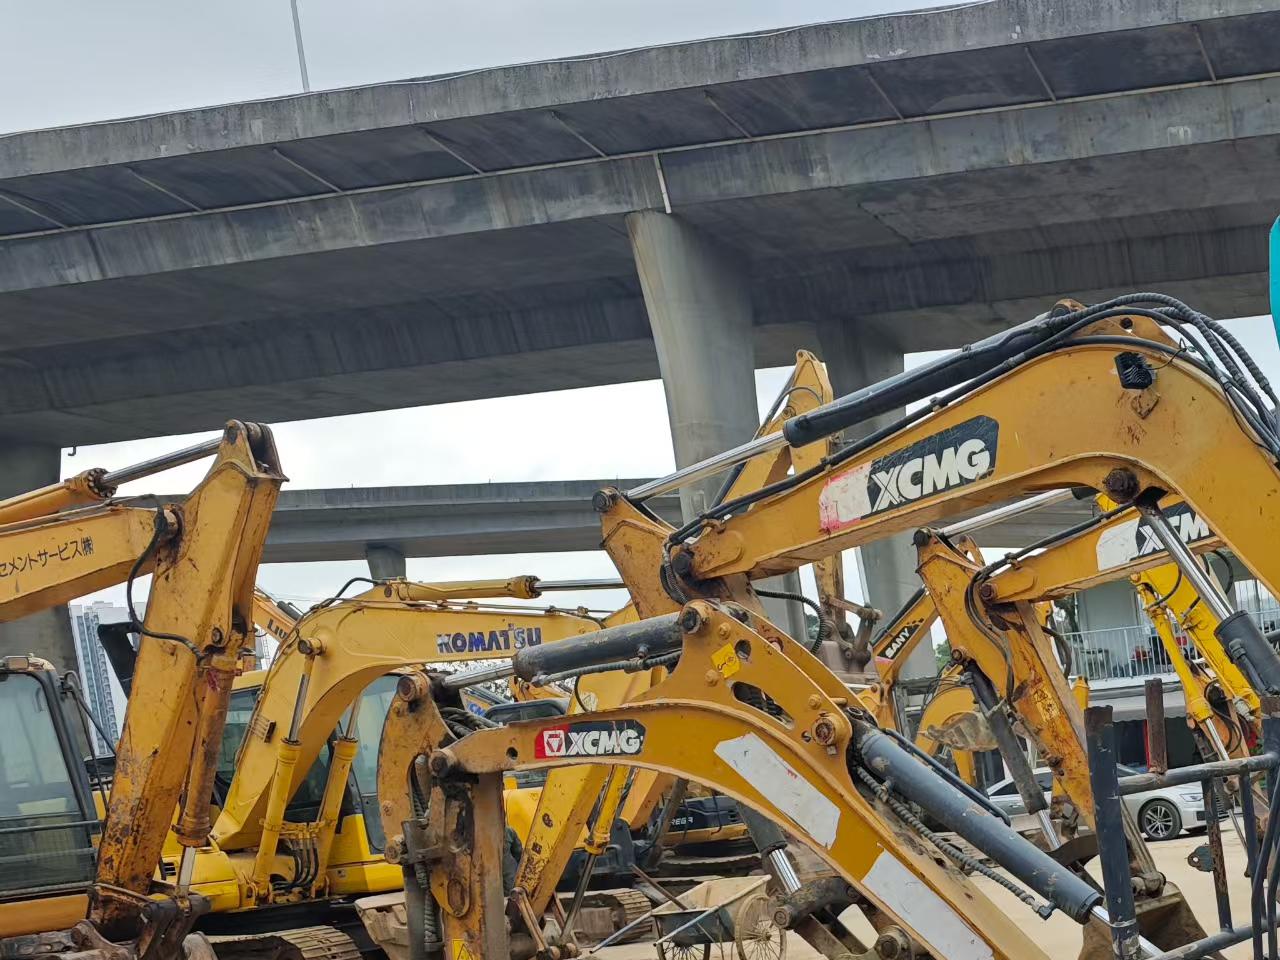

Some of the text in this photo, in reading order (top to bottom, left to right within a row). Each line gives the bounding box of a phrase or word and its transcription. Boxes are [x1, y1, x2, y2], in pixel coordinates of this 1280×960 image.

[871, 438, 990, 512] XCMG
[436, 626, 542, 654] KOMATSU
[885, 627, 910, 658] SANY
[567, 729, 640, 755] XCMG
